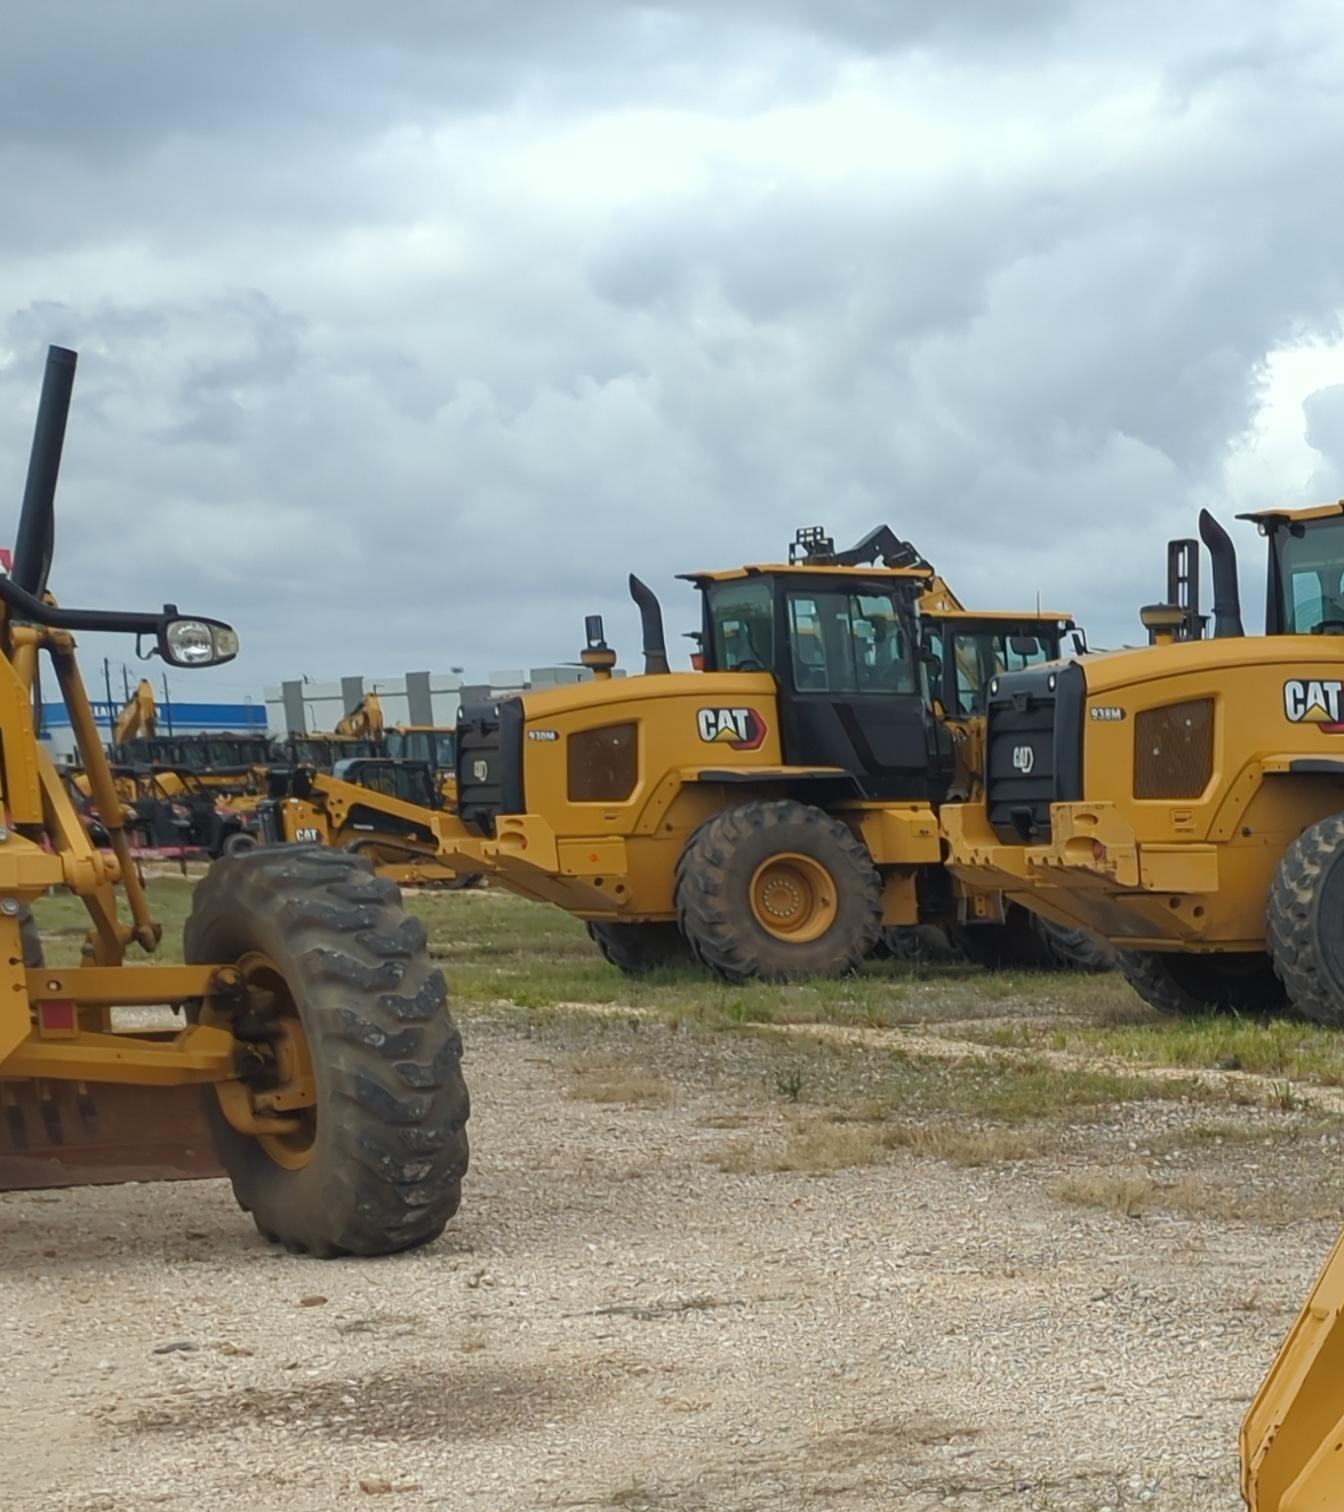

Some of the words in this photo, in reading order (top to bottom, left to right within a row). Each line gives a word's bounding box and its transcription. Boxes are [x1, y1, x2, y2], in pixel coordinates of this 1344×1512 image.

[1284, 682, 1343, 723] CAT
[697, 709, 749, 742] CAT
[1090, 708, 1122, 721] 938M
[296, 829, 317, 841] CAT
